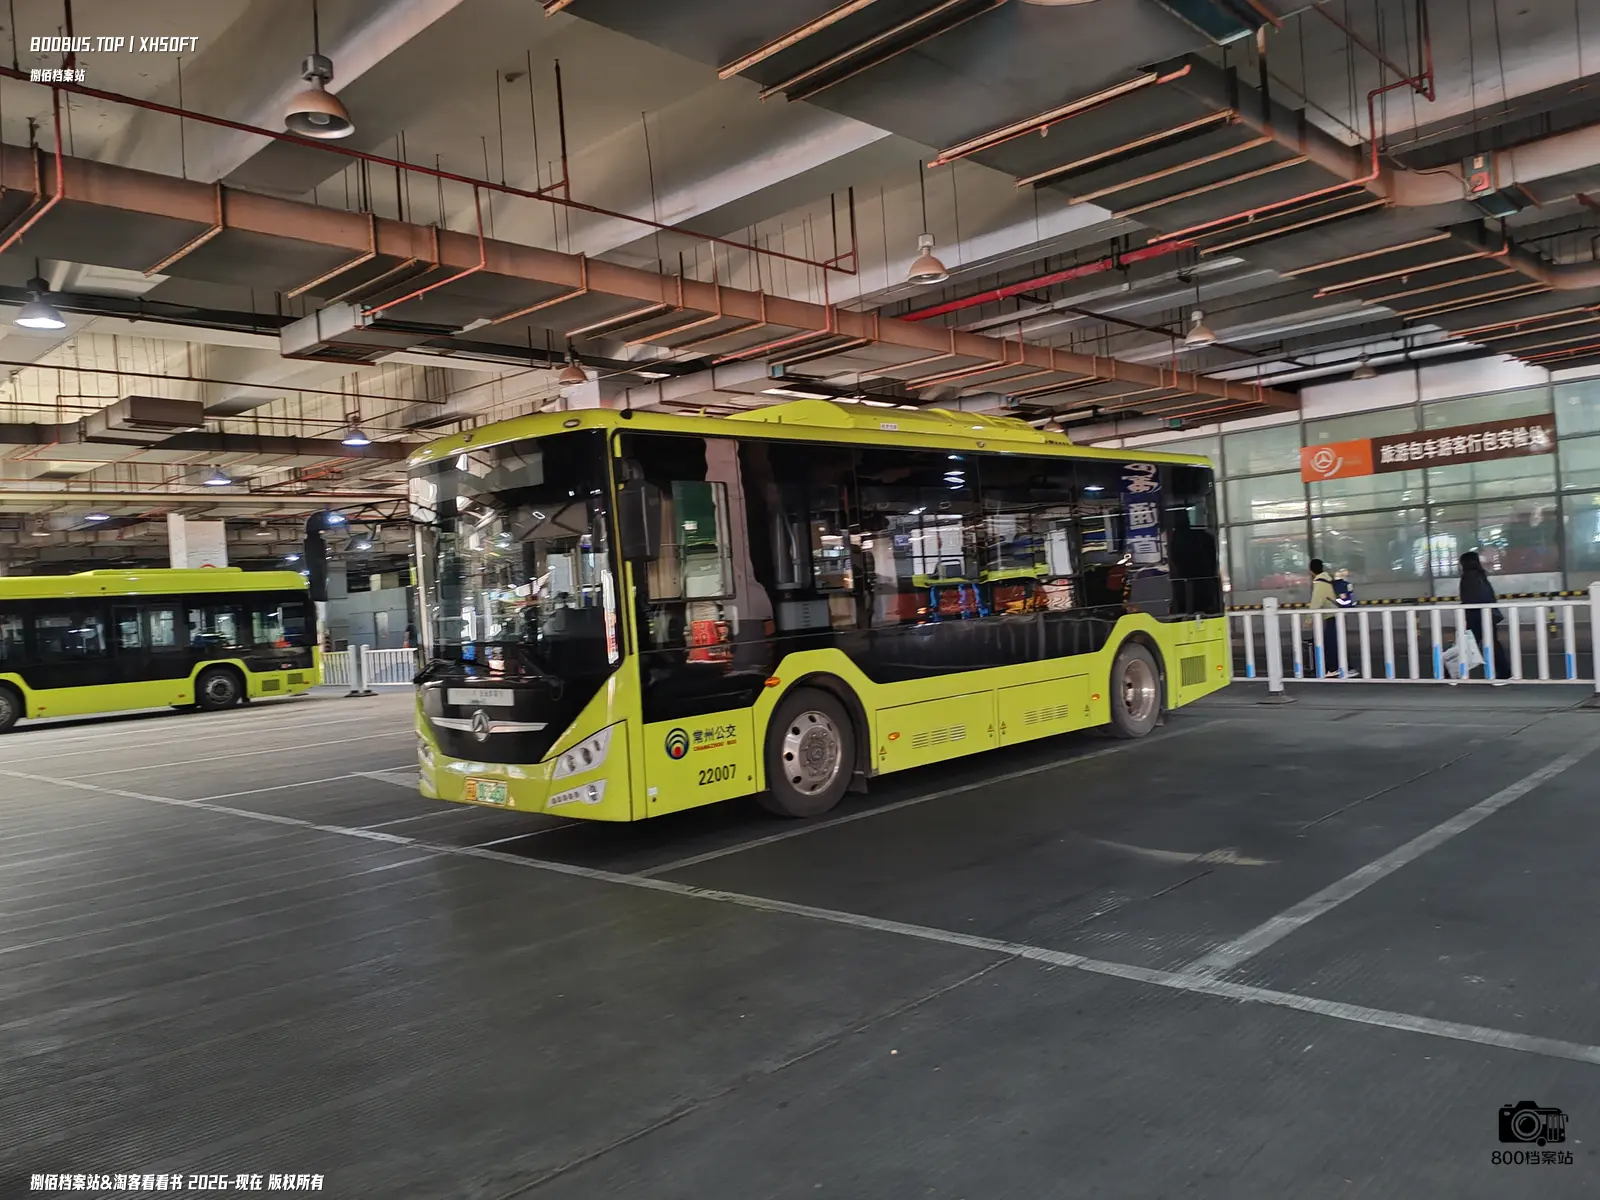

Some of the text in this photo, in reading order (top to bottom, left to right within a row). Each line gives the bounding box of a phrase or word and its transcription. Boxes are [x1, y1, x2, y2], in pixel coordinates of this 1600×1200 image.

[692, 723, 737, 744] 常州公交
[698, 763, 737, 786] 22007
